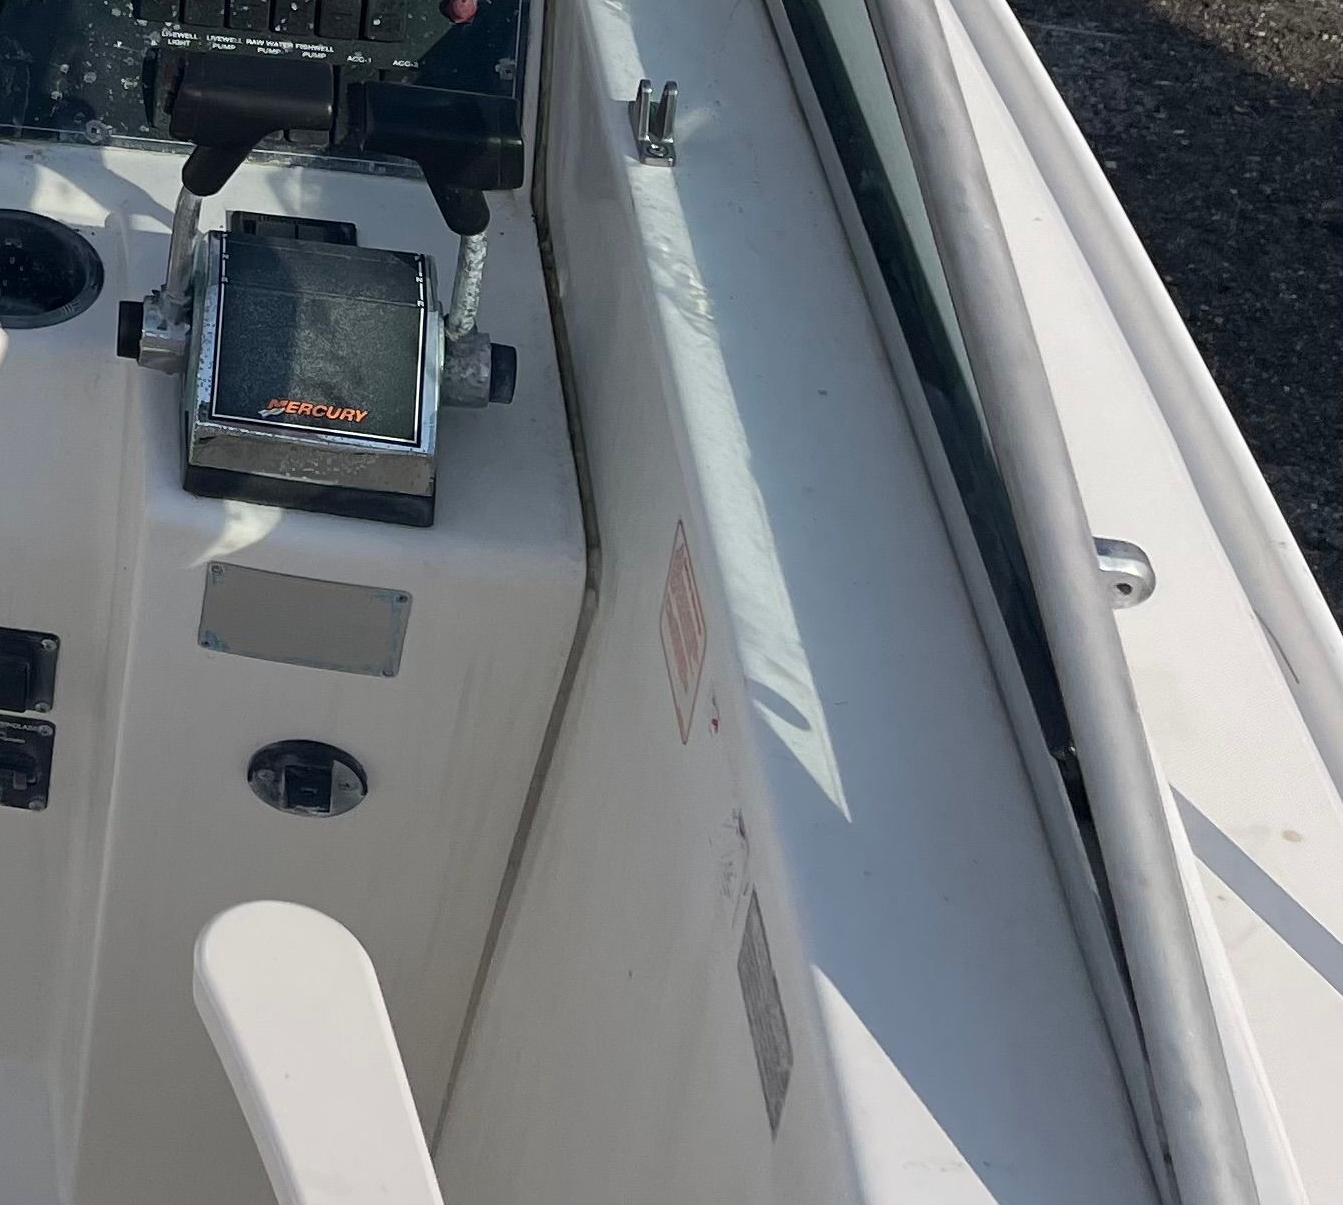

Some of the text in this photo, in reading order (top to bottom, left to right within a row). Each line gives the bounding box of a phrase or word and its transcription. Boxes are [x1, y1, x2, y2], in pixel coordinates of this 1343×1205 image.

[161, 31, 198, 40] LIVEWELL
[206, 34, 243, 44] LIVEWELL
[167, 39, 191, 47] LIGHT
[245, 38, 294, 49] RAW WATER
[257, 47, 281, 55] PUMP
[302, 51, 326, 59] PUMP
[268, 399, 368, 422] MERCURY
